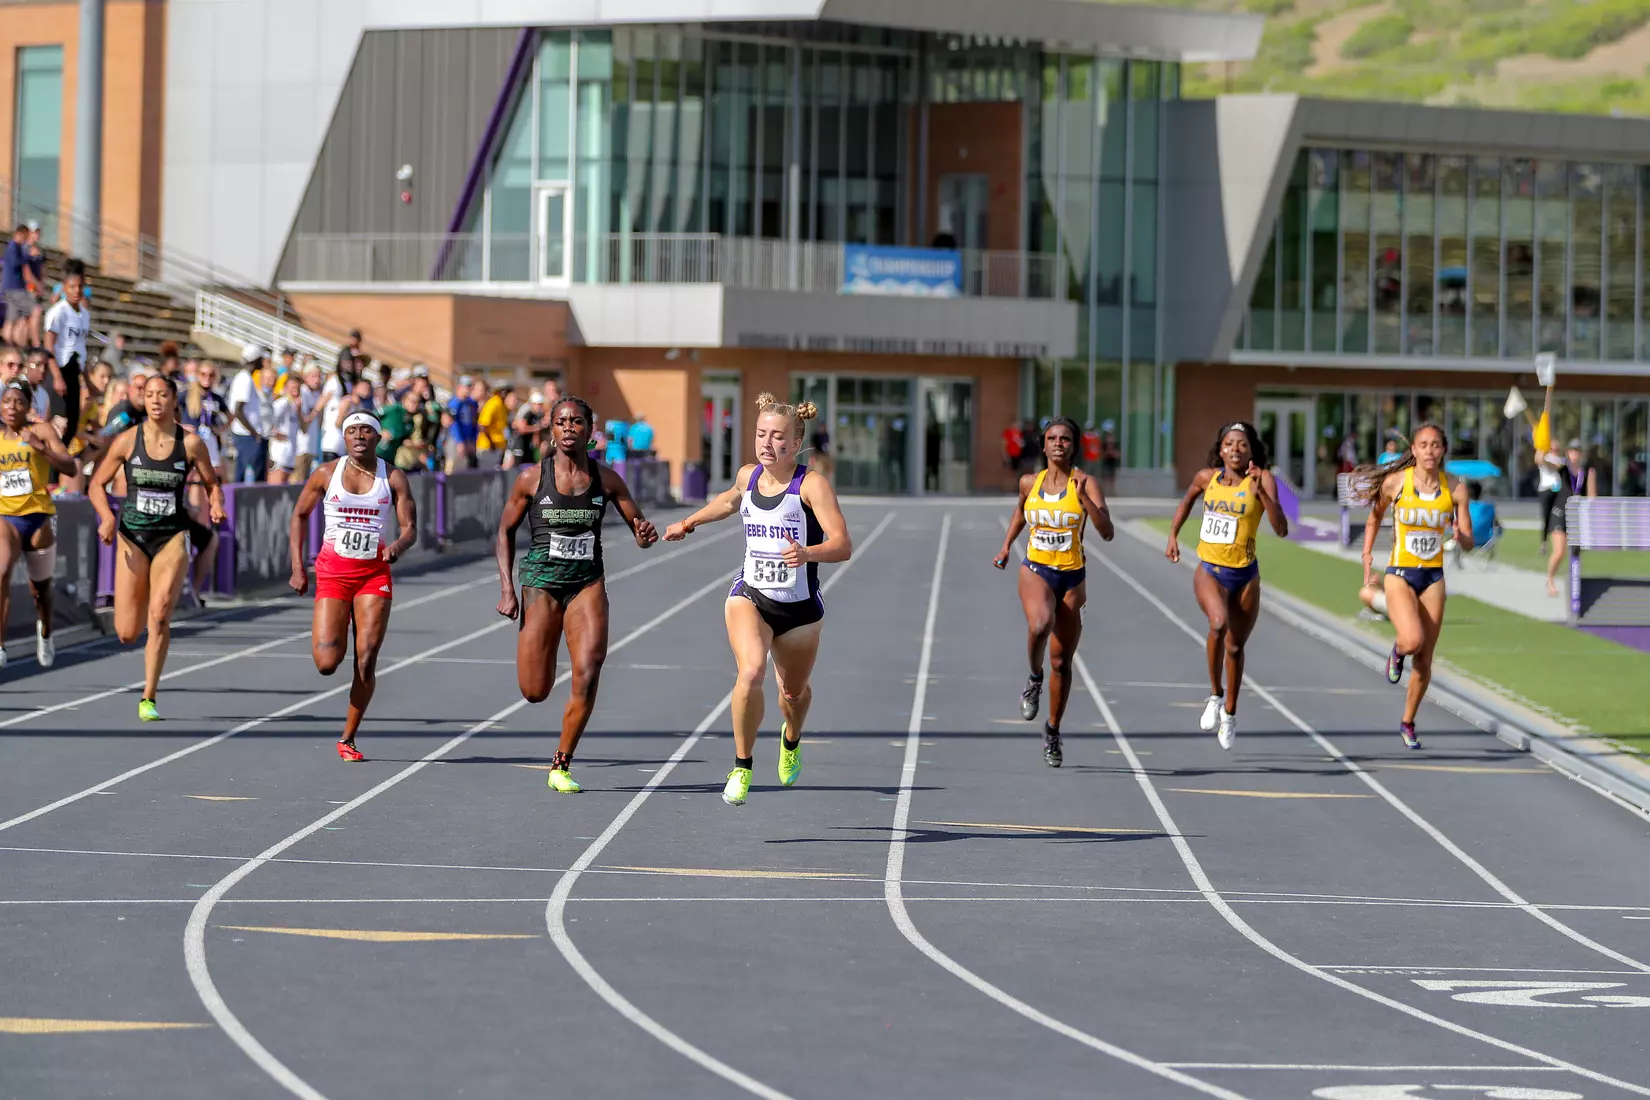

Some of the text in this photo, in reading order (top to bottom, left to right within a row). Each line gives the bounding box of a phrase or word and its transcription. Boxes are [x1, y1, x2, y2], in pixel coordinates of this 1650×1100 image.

[542, 508, 600, 519] SACRAMENTO
[1204, 500, 1246, 514] NAU
[1024, 508, 1080, 528] UNC
[1205, 517, 1230, 538] 364
[342, 530, 371, 552] 491
[556, 537, 588, 556] 445
[1411, 537, 1436, 553] 402
[754, 560, 788, 583] 538
